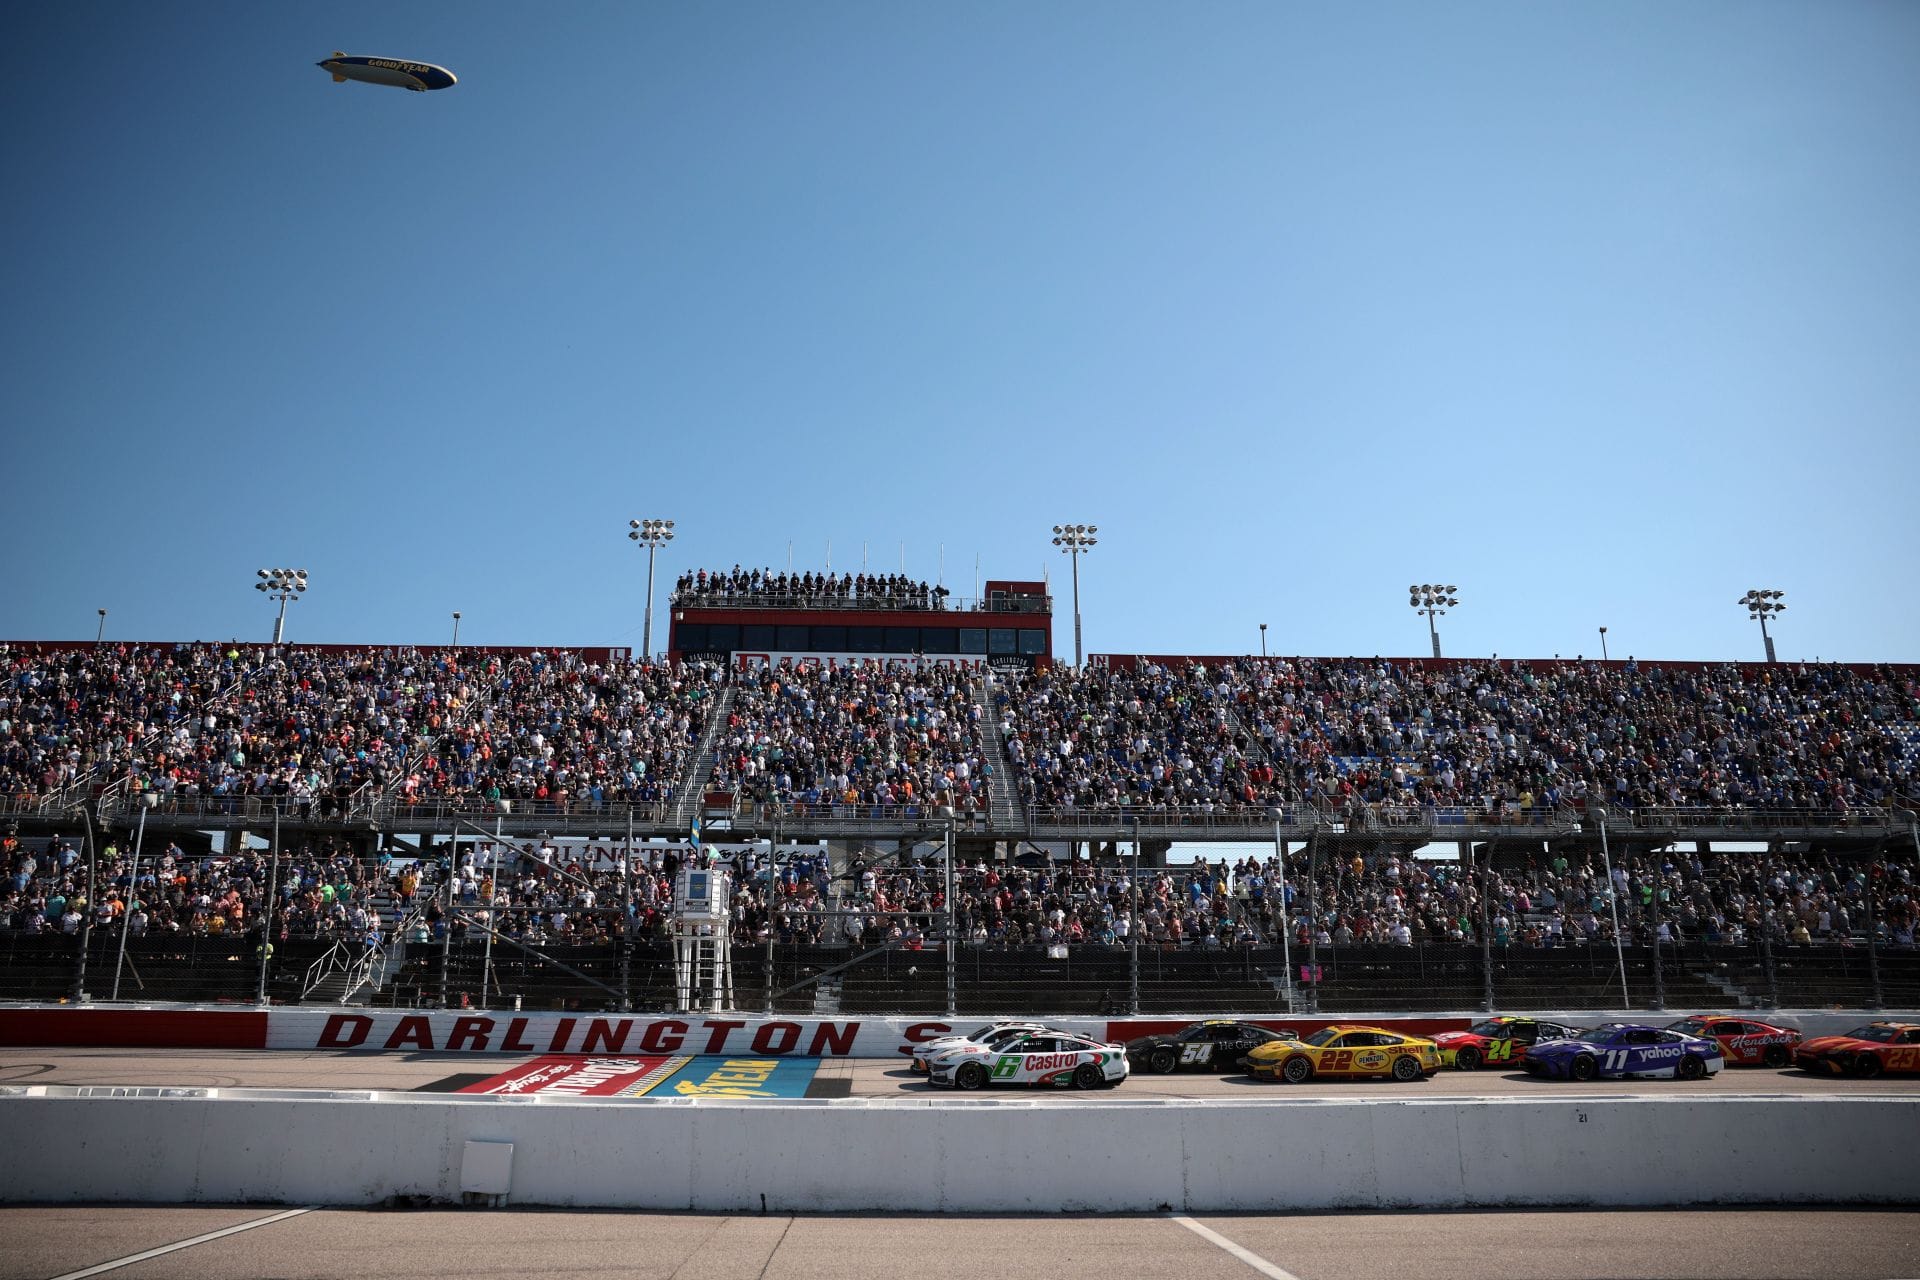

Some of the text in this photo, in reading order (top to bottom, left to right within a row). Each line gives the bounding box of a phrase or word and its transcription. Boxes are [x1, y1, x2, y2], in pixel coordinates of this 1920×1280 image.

[367, 59, 430, 73] GOODYEAR
[316, 1015, 860, 1056] DARLINGTON
[1729, 1034, 1794, 1049] Hendrick
[1180, 1043, 1214, 1064] 54
[1219, 1041, 1234, 1051] He
[1236, 1041, 1258, 1050] Gets
[1388, 1046, 1423, 1054] Shell
[1488, 1040, 1512, 1060] 24
[1639, 1043, 1686, 1063] yahoo!
[991, 1055, 1023, 1079] 6
[1025, 1053, 1079, 1072] Castrol
[1316, 1051, 1353, 1070] 22
[1359, 1055, 1385, 1064] PENNZOIL
[1605, 1050, 1629, 1070] 11
[1886, 1048, 1917, 1068] 23
